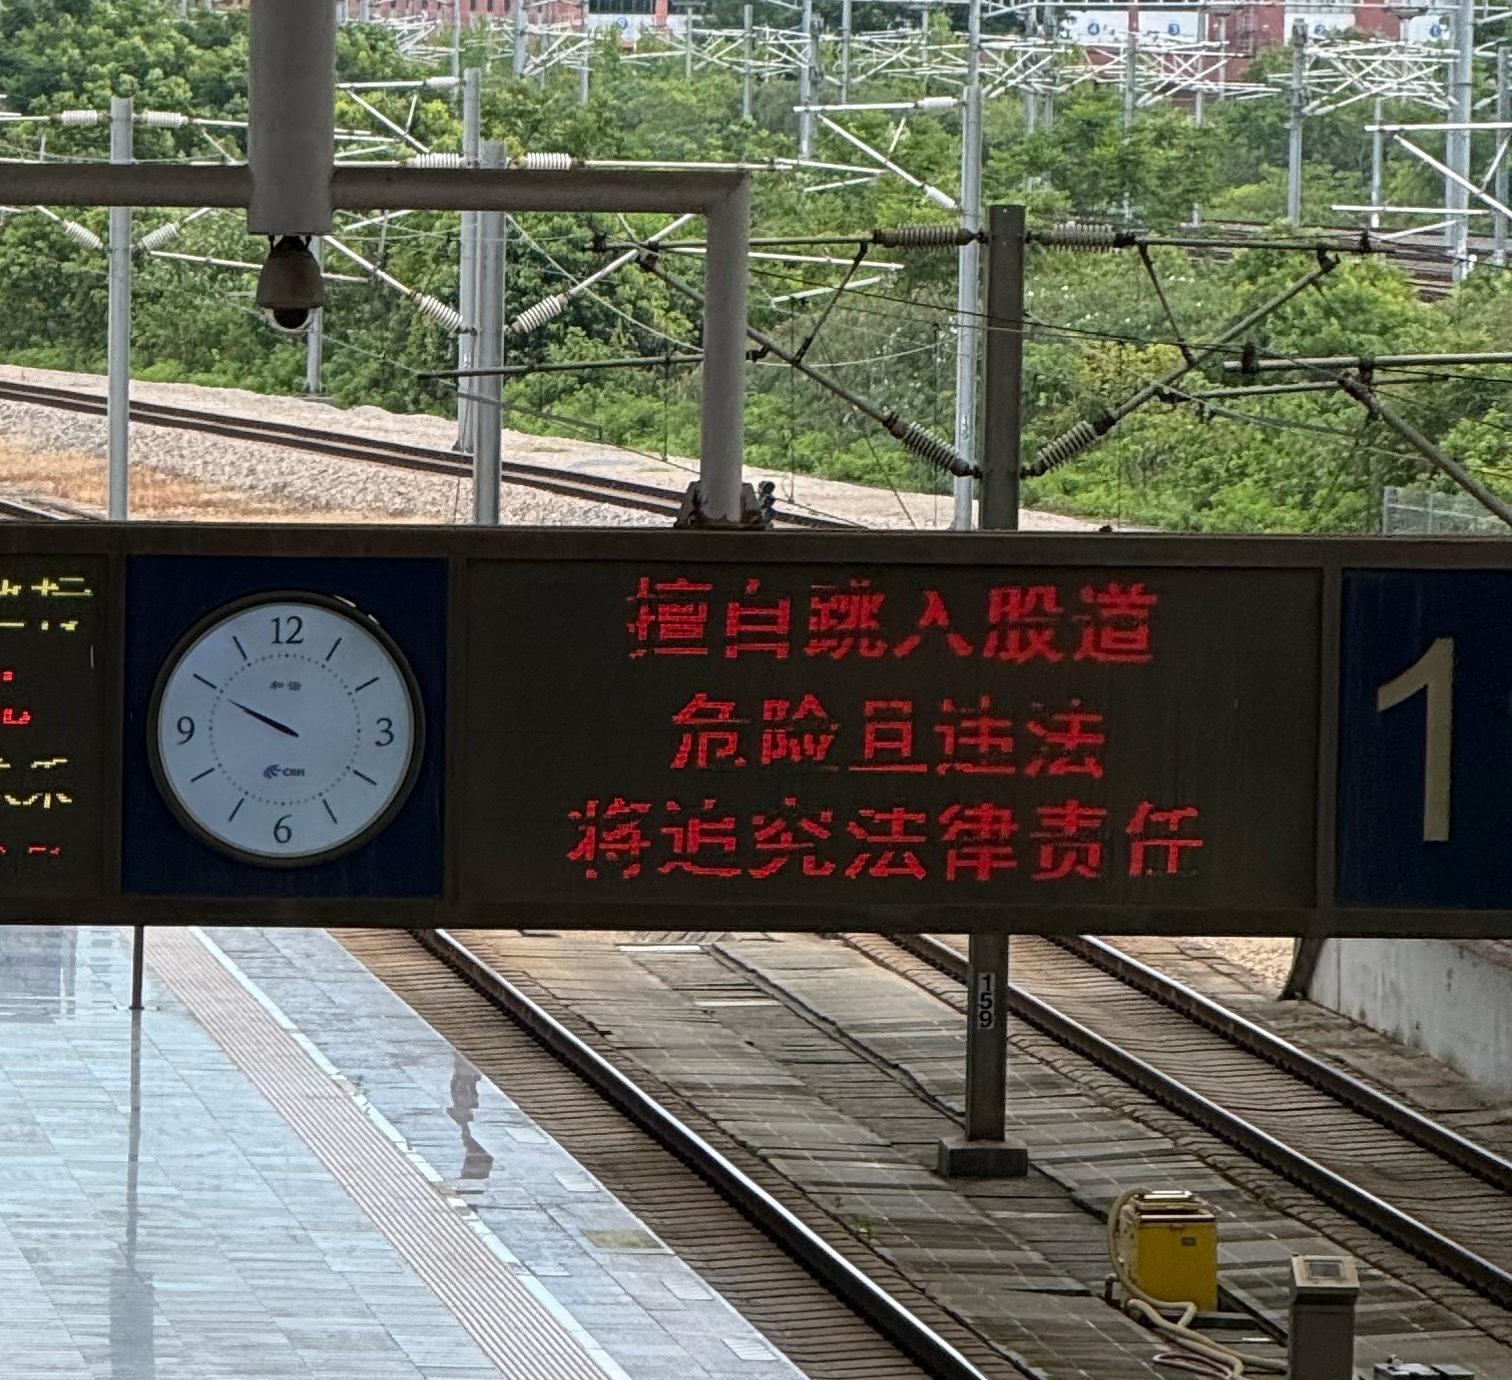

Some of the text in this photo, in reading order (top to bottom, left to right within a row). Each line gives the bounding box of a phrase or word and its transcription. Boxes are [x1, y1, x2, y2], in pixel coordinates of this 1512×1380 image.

[270, 615, 304, 645] 12
[626, 577, 1159, 664] 擅自跳入股道
[176, 716, 196, 746] 9
[374, 717, 395, 747] 3
[670, 692, 1106, 778] 危险且违法
[1377, 636, 1454, 841] 1
[273, 814, 293, 844] 6
[567, 797, 1204, 879] 将追究法律责任
[980, 974, 993, 1028] 159
